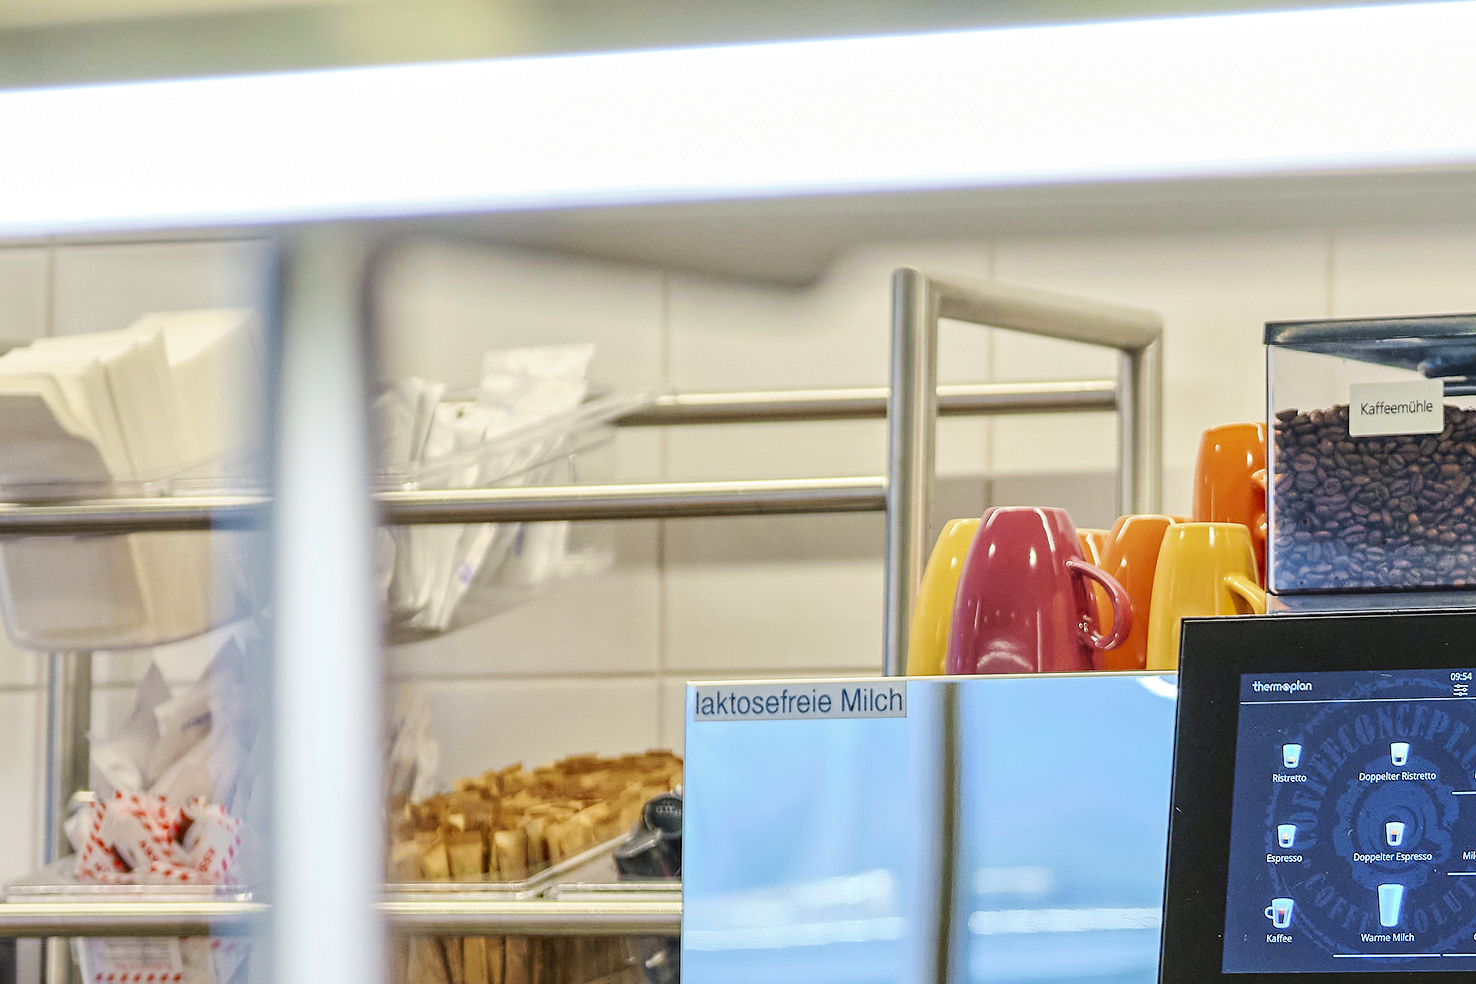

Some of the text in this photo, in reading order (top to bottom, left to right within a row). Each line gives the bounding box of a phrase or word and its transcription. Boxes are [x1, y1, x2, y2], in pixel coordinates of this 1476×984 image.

[1359, 399, 1434, 416] Kaffeemühle
[1449, 671, 1473, 682] 09:54
[1251, 679, 1313, 695] thermoplan
[695, 687, 903, 716] laktosefreie Milch
[1272, 772, 1308, 784] Ristretto
[1358, 770, 1438, 785] Doppelter Ristretto
[1266, 853, 1303, 865] Espresso
[1353, 851, 1433, 865] Doppelter Espresso
[1266, 932, 1293, 944] Kaffee
[1360, 931, 1415, 943] Warme Milch
